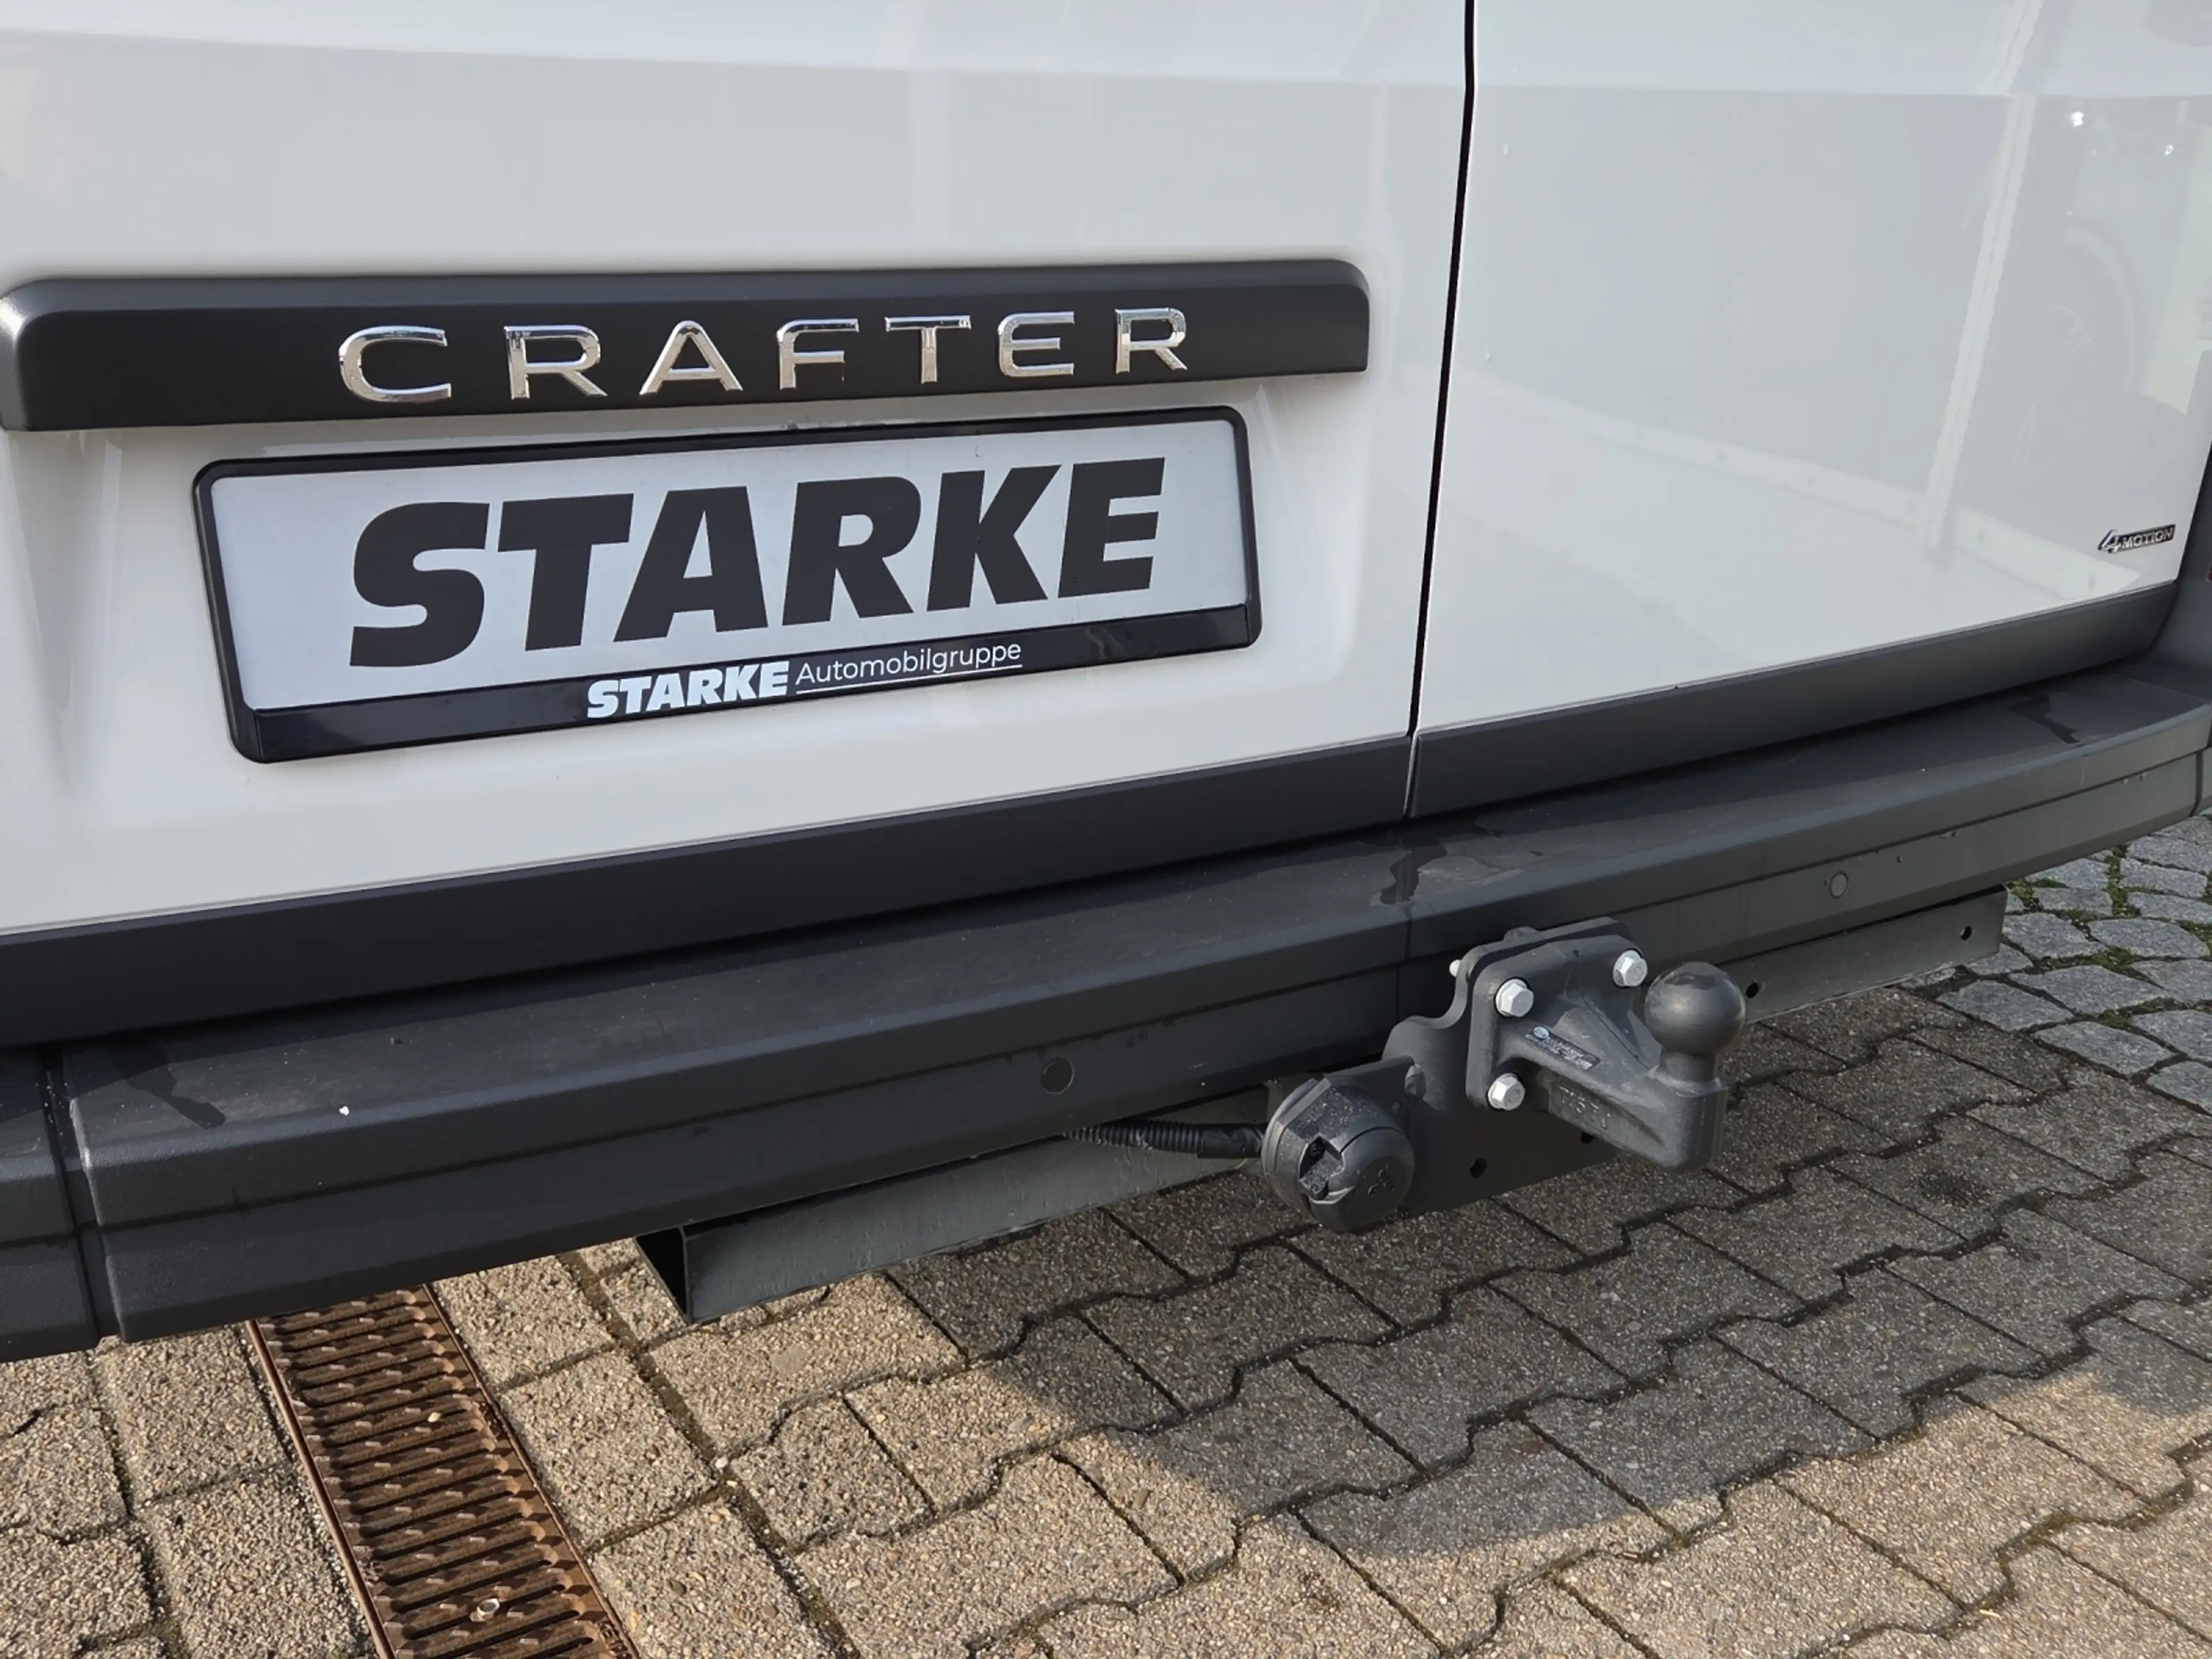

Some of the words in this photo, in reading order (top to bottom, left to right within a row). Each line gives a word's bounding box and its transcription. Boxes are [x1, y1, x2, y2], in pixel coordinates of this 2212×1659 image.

[339, 307, 1188, 403] CRAFTER
[350, 457, 1166, 667] STARKE
[587, 660, 790, 718] STARKE
[796, 641, 1022, 685] Automobilgruppe
